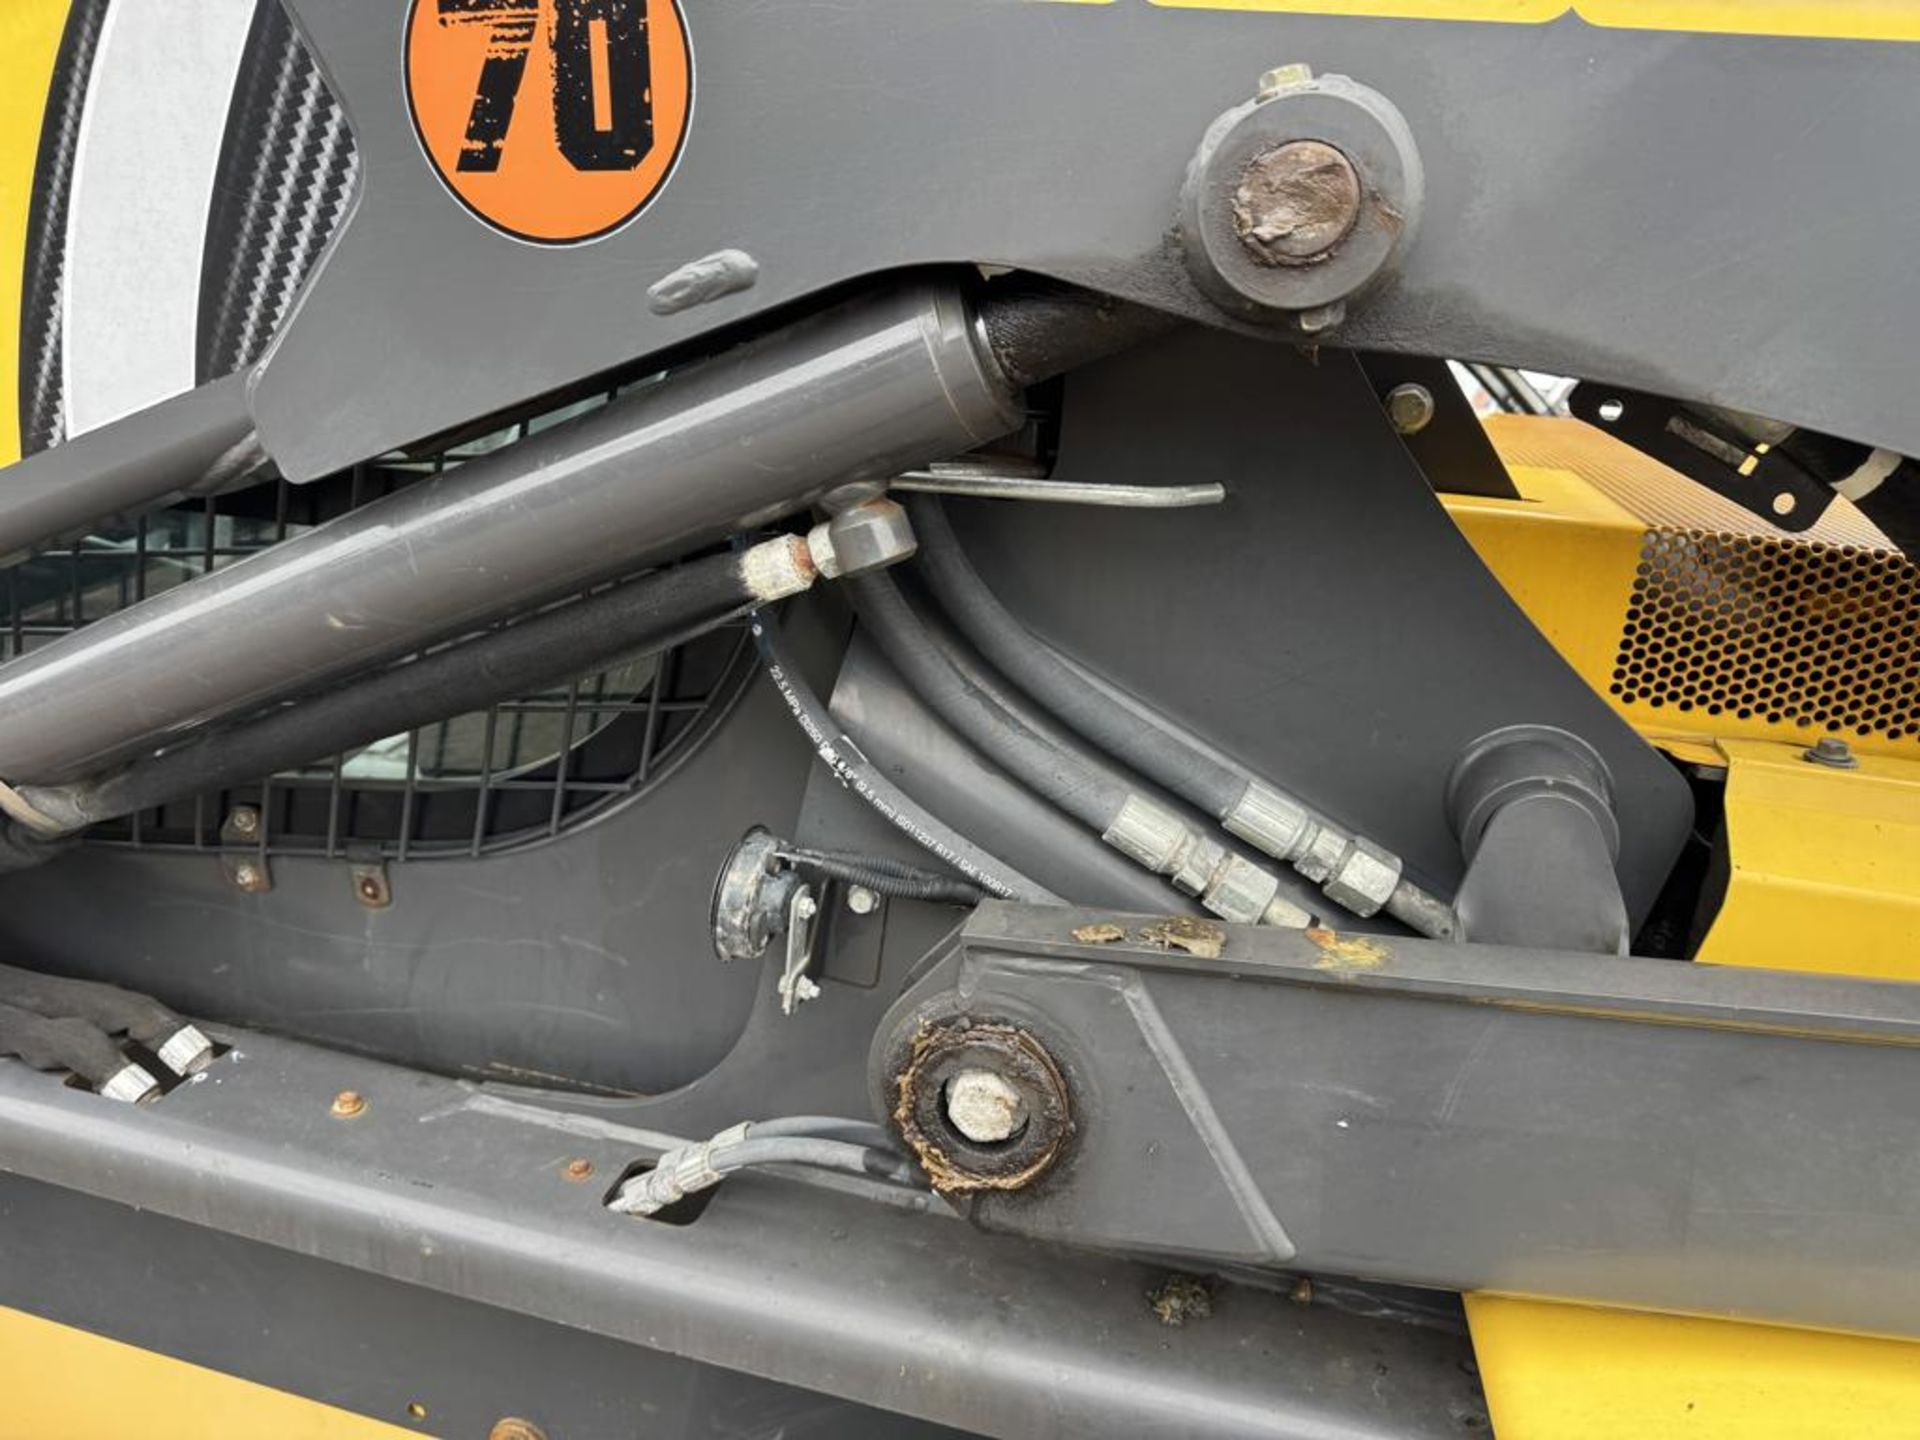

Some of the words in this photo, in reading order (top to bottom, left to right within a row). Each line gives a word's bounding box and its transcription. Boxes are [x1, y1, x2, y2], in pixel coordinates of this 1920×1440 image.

[438, 0, 654, 172] 70
[769, 665, 788, 691] 22.5
[784, 689, 801, 716] MPa
[935, 844, 956, 860] R17
[978, 871, 1014, 897] 100R17
